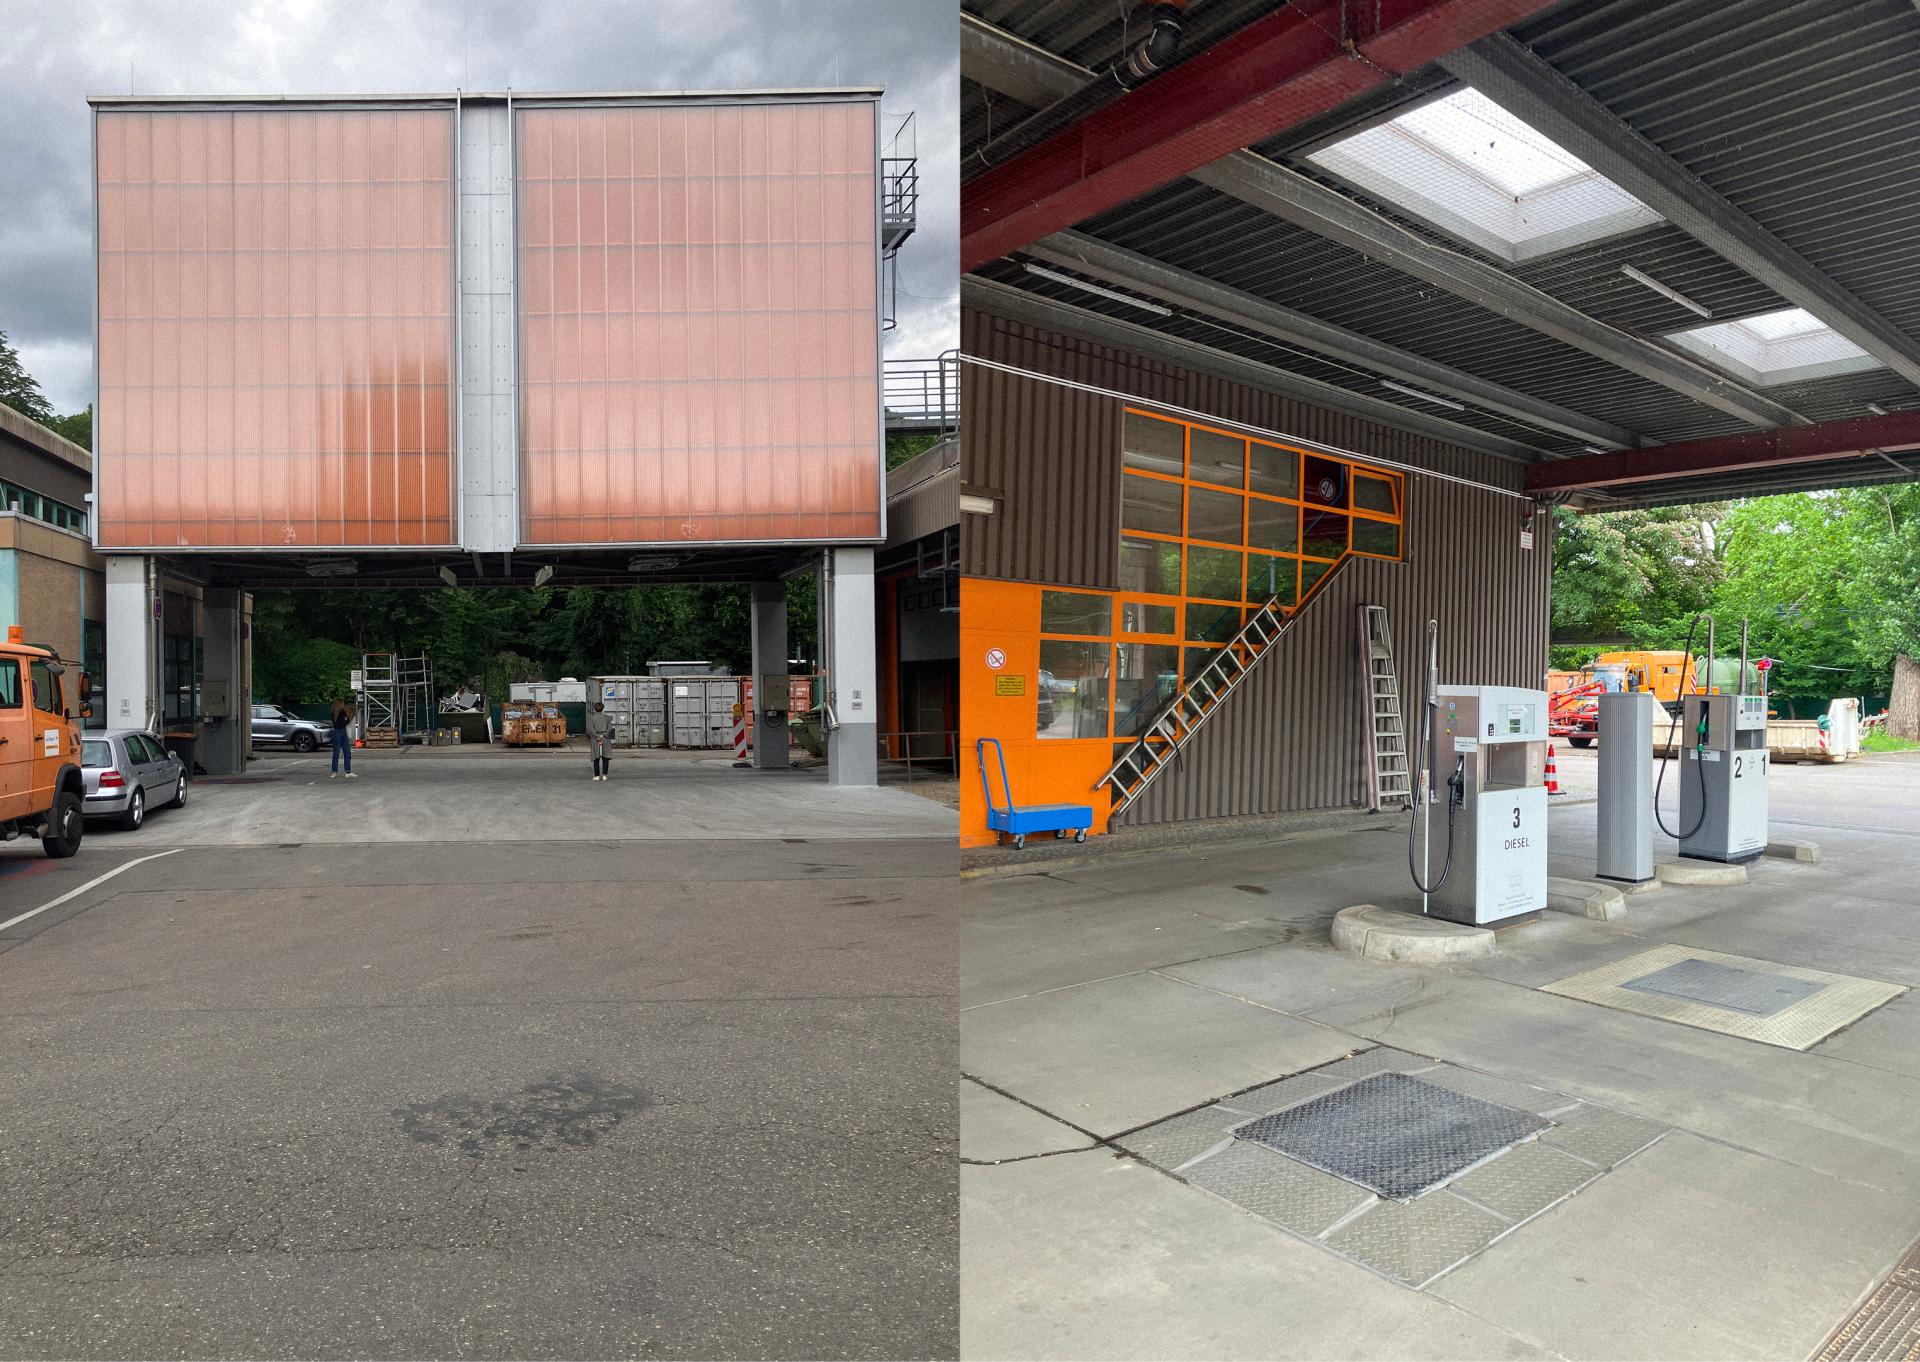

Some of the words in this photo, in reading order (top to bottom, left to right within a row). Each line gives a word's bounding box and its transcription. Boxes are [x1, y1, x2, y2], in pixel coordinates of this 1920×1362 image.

[552, 725, 561, 734] 31
[1735, 757, 1742, 778] 2
[1762, 755, 1766, 775] 1
[1513, 807, 1520, 828] 3
[1504, 837, 1530, 850] DIESEL
